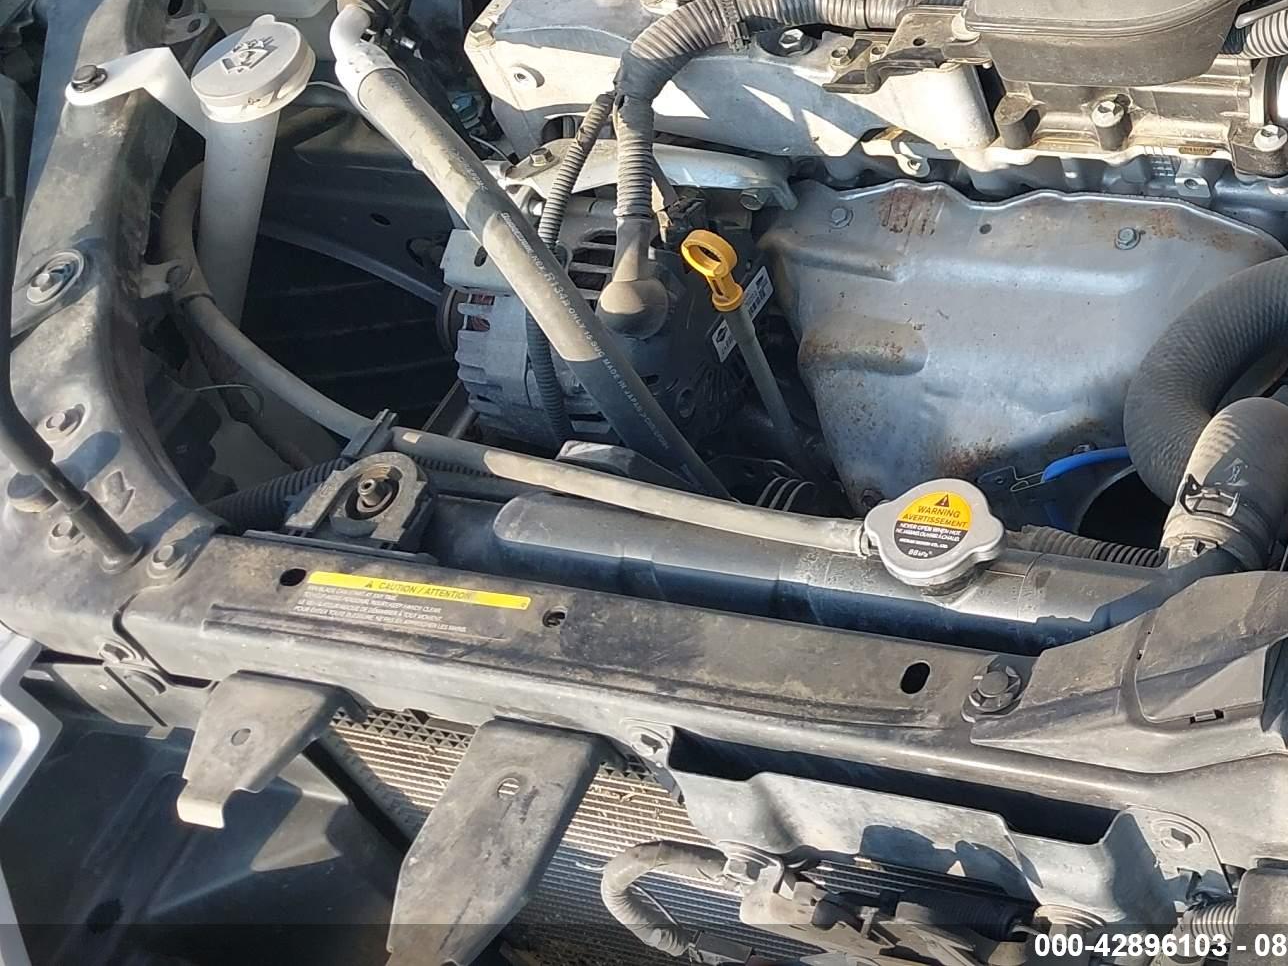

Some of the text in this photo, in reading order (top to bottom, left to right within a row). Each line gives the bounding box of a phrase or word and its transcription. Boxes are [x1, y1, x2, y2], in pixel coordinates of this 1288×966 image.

[602, 358, 620, 380] MADE
[918, 506, 960, 518] WARNING
[903, 514, 968, 528] AVERTISSEMENT
[379, 581, 416, 594] CAUTION
[425, 587, 471, 600] ATTENTION
